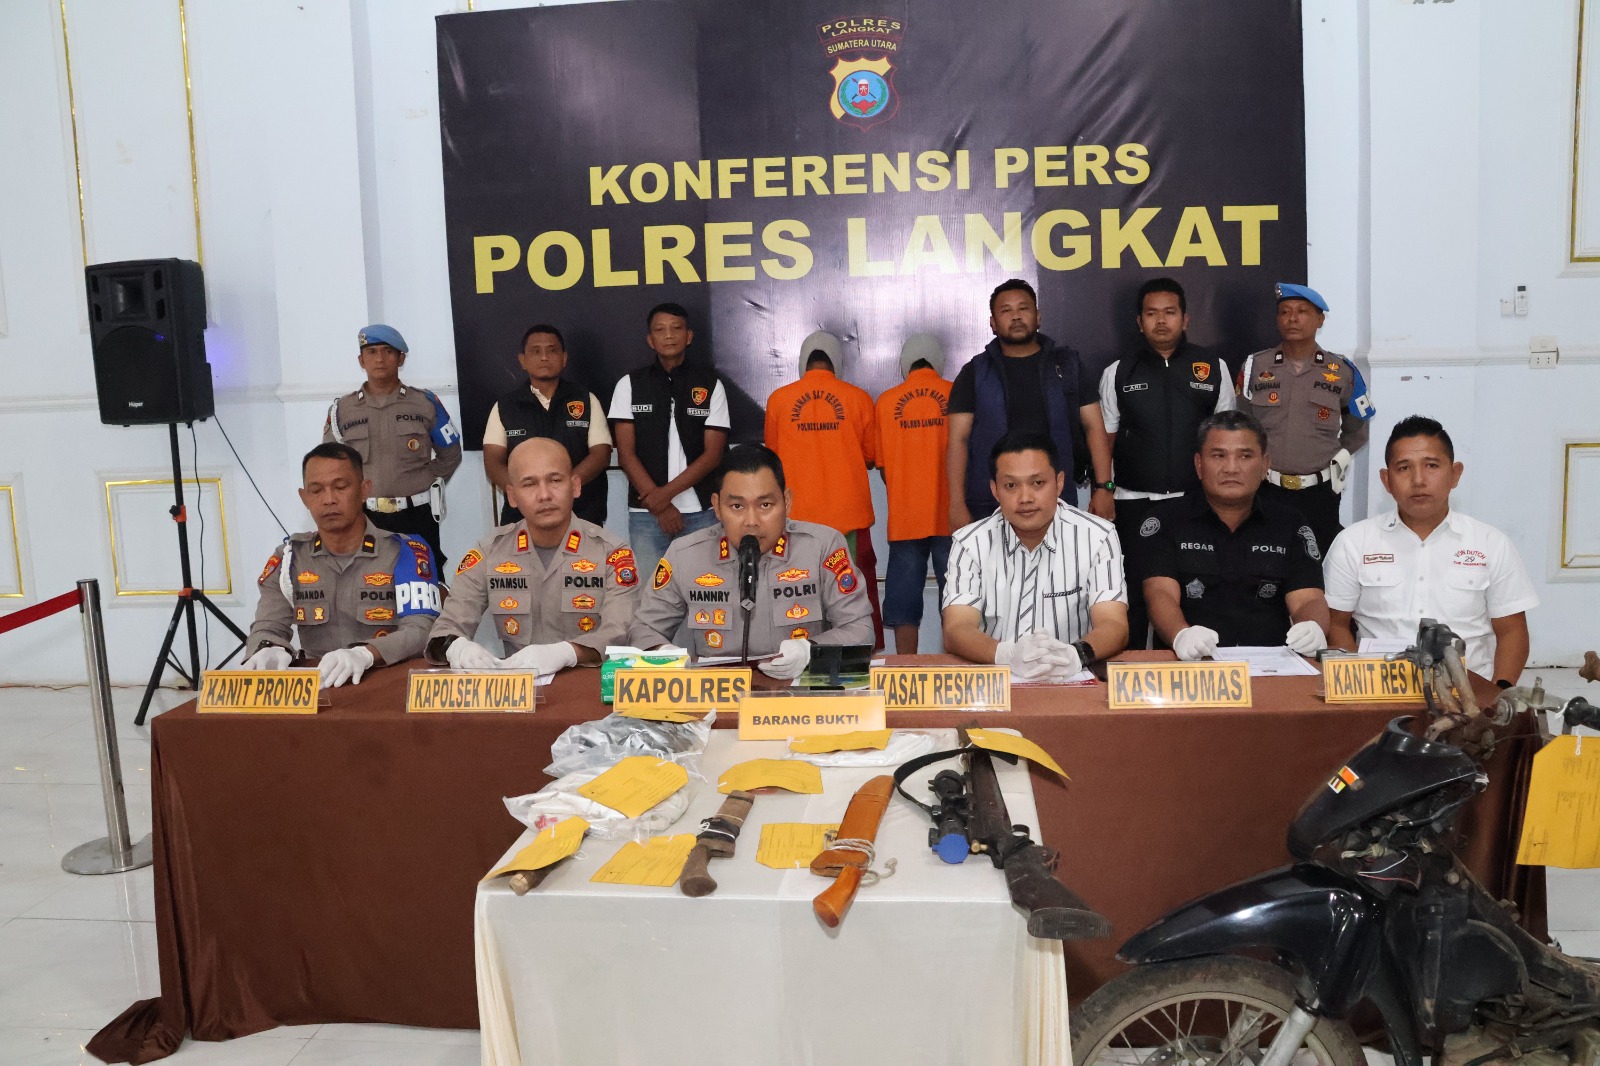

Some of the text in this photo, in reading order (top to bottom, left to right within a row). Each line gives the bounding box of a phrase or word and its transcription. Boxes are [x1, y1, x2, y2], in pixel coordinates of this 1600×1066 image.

[821, 18, 901, 34] POLRES
[831, 26, 892, 37] LANGKAT
[827, 39, 897, 54] SUMATERA UTARA
[590, 142, 1151, 206] KONFERENSI PERS
[474, 204, 1280, 294] POLRES LANGKAT
[812, 390, 825, 400] SAT
[915, 388, 929, 398] SAT
[1313, 381, 1342, 395] POLRI
[396, 414, 424, 423] POLRI
[1180, 542, 1214, 552] REGAR
[1251, 545, 1286, 555] POLRI
[1466, 549, 1486, 560] DUTCH
[490, 577, 528, 590] SYAMSUL
[564, 576, 603, 589] POLRI
[689, 590, 730, 602] HANNRY
[773, 583, 817, 599] POLRI
[1115, 669, 1243, 703] KASI HUMAS
[1332, 662, 1376, 696] KANIT
[205, 677, 314, 707] KANIT PROVOS
[414, 677, 527, 708] KAPOLSEK KUALA
[618, 677, 746, 704] KAPOLRES
[876, 672, 1005, 706] KASAT RESKRIM
[752, 714, 859, 726] BARANG BUKTI
